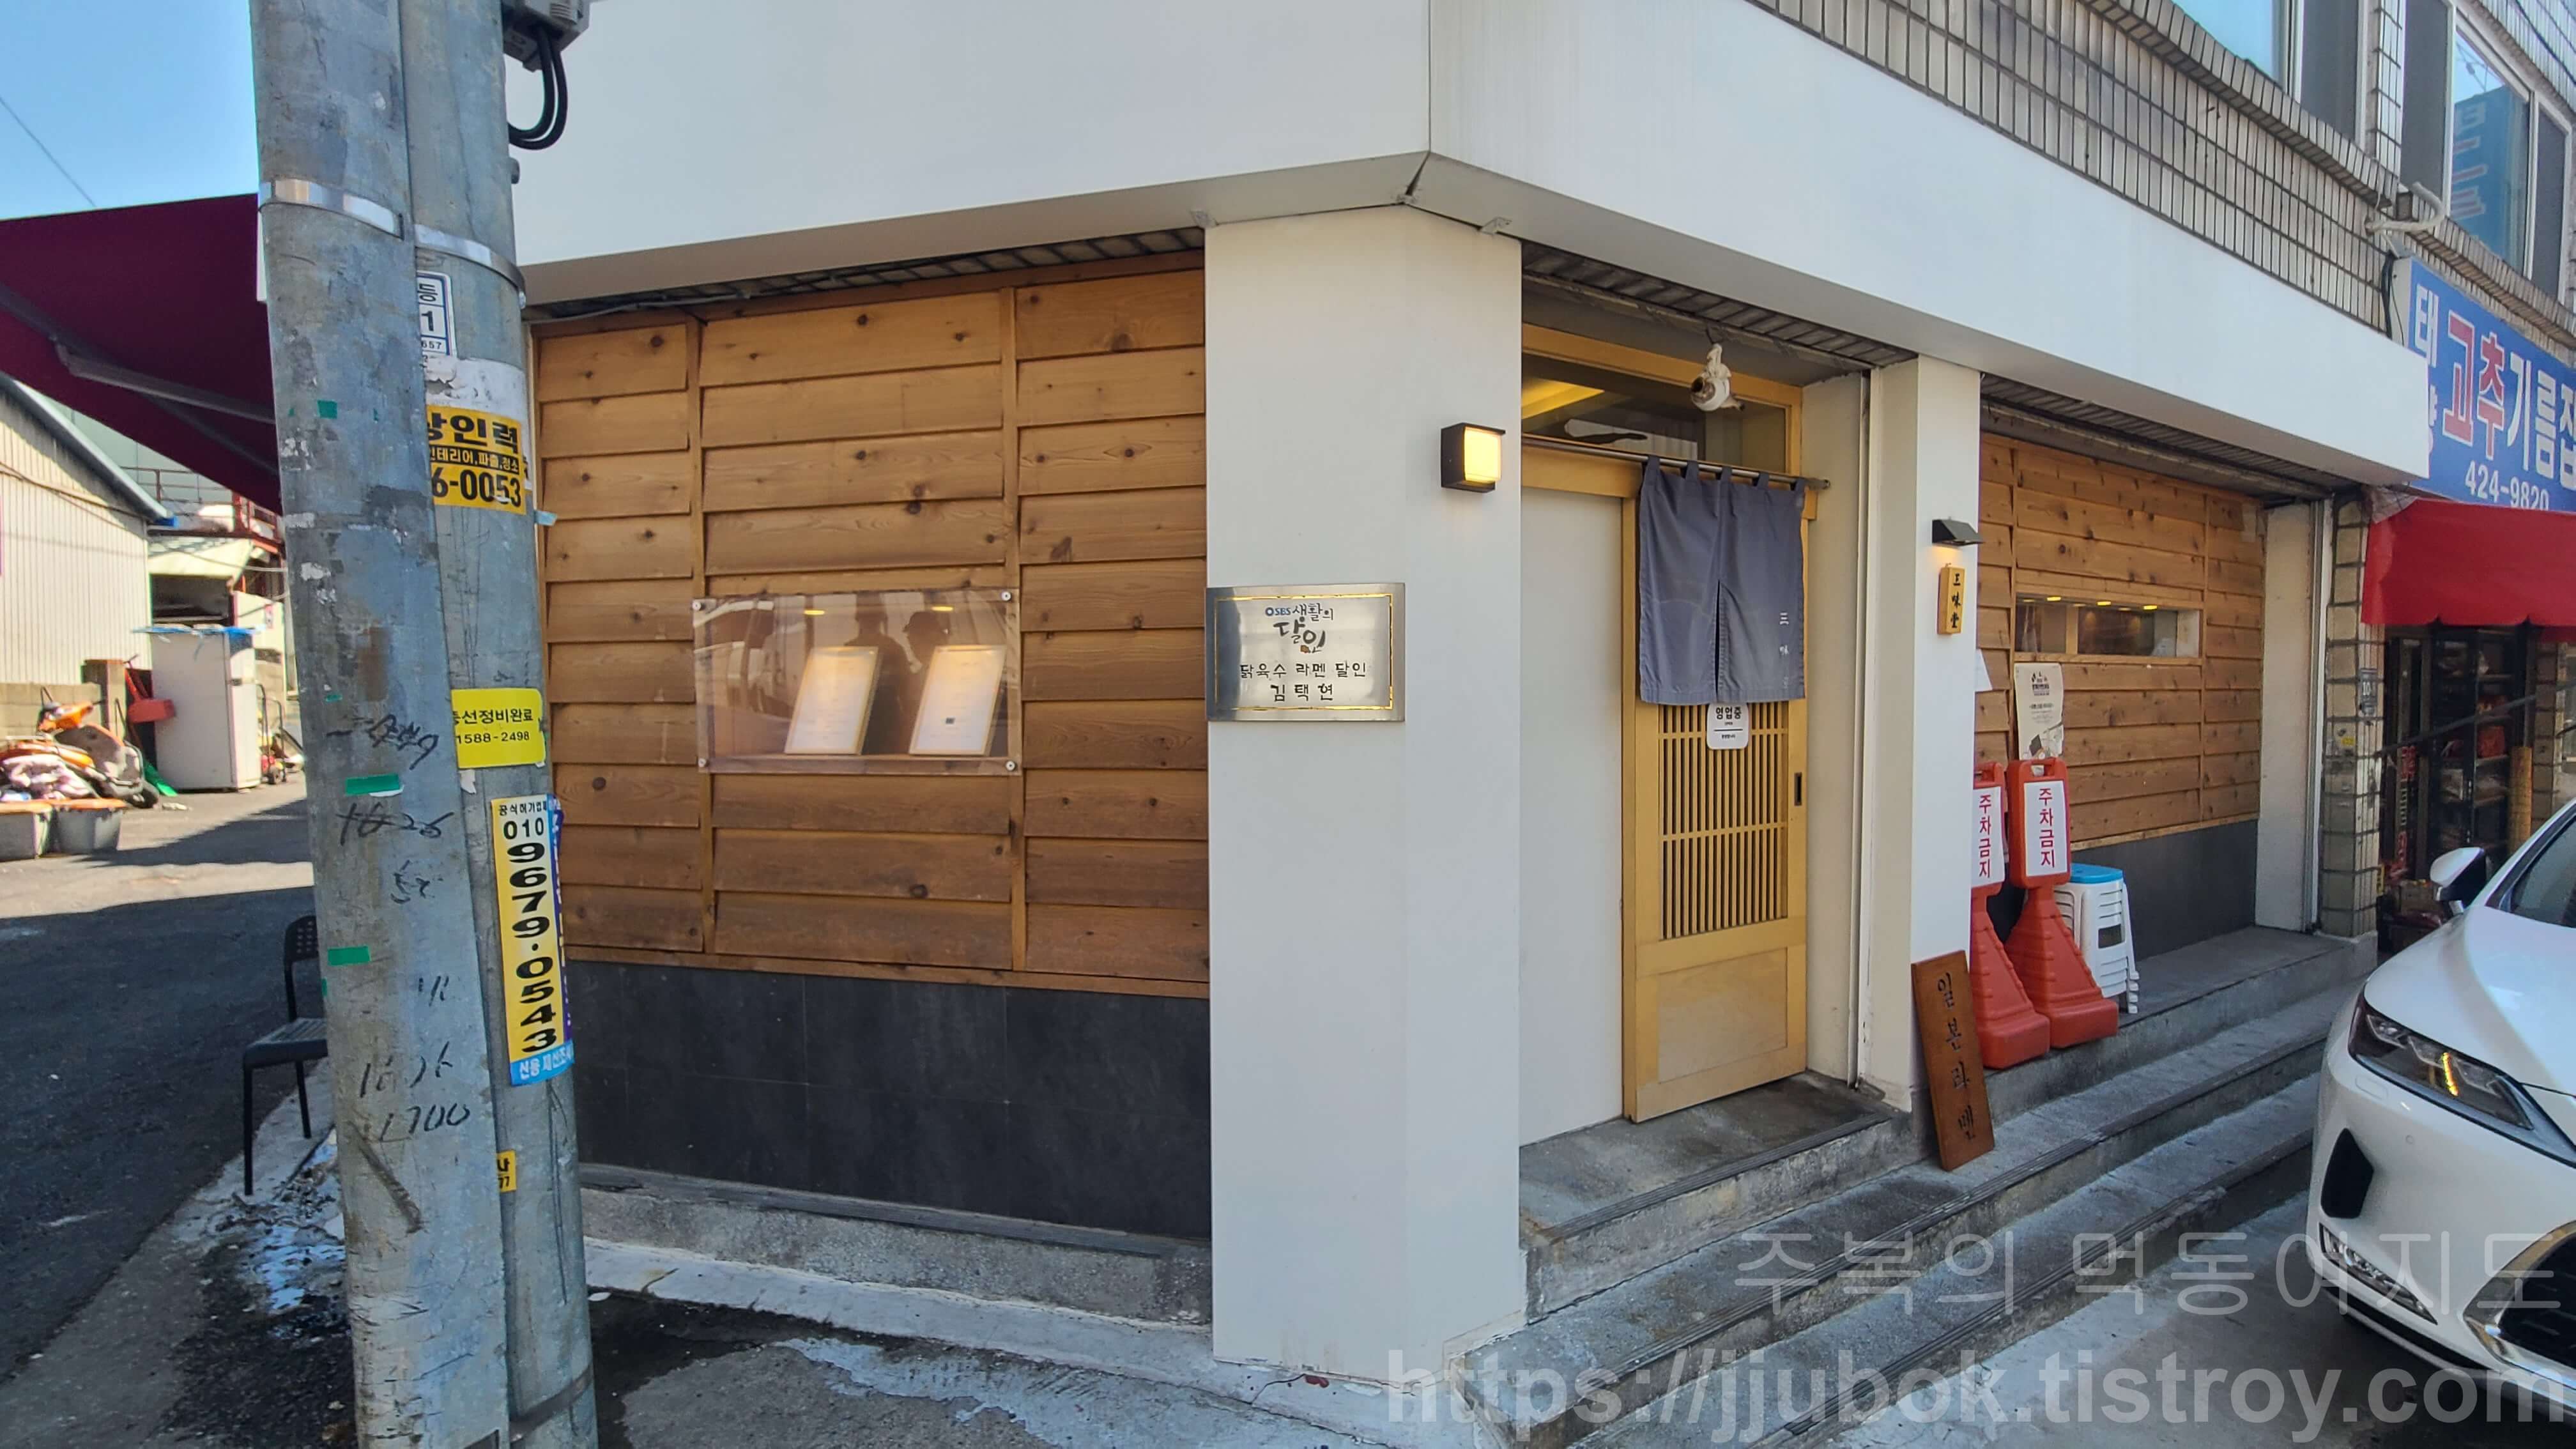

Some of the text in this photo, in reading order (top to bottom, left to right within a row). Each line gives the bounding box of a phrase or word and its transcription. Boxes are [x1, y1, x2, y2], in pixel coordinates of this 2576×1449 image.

[2465, 460, 2549, 510] 424-9820
[1292, 602, 1334, 622] 생활의
[1273, 618, 1326, 654] 달인
[1239, 660, 1367, 678] 닭육수 라멘 달인
[1715, 706, 1742, 719] 영업중
[456, 730, 530, 744] 1588-2498
[503, 817, 544, 839] 010
[1979, 794, 1992, 878] 주차금지
[2039, 787, 2055, 868] 주차금지
